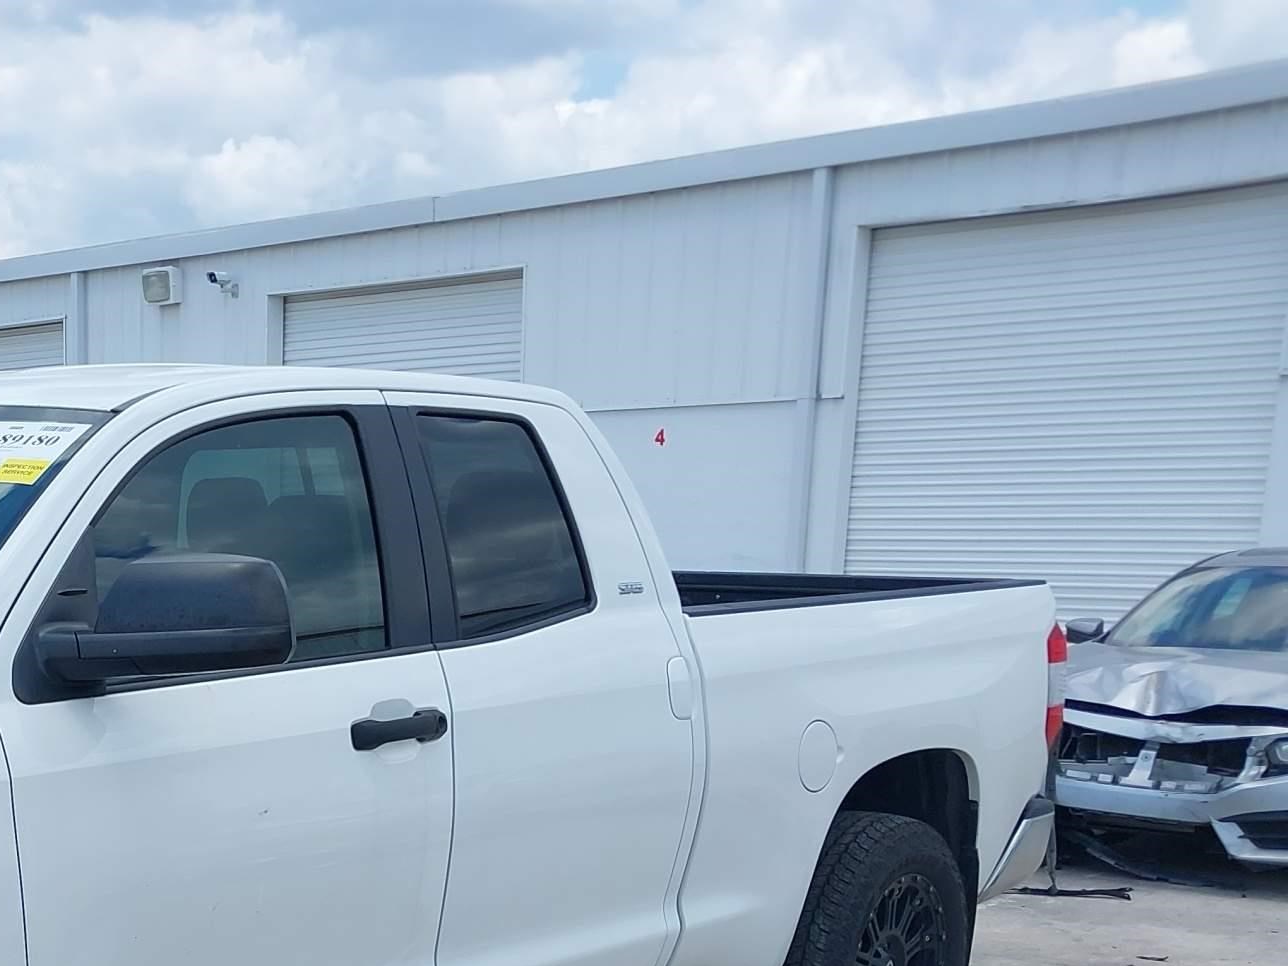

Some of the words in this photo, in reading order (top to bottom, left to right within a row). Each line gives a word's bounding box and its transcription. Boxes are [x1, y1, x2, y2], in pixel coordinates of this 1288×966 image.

[654, 427, 666, 446] 4
[2, 463, 46, 472] INSPECTION
[1, 469, 34, 477] SERVICE
